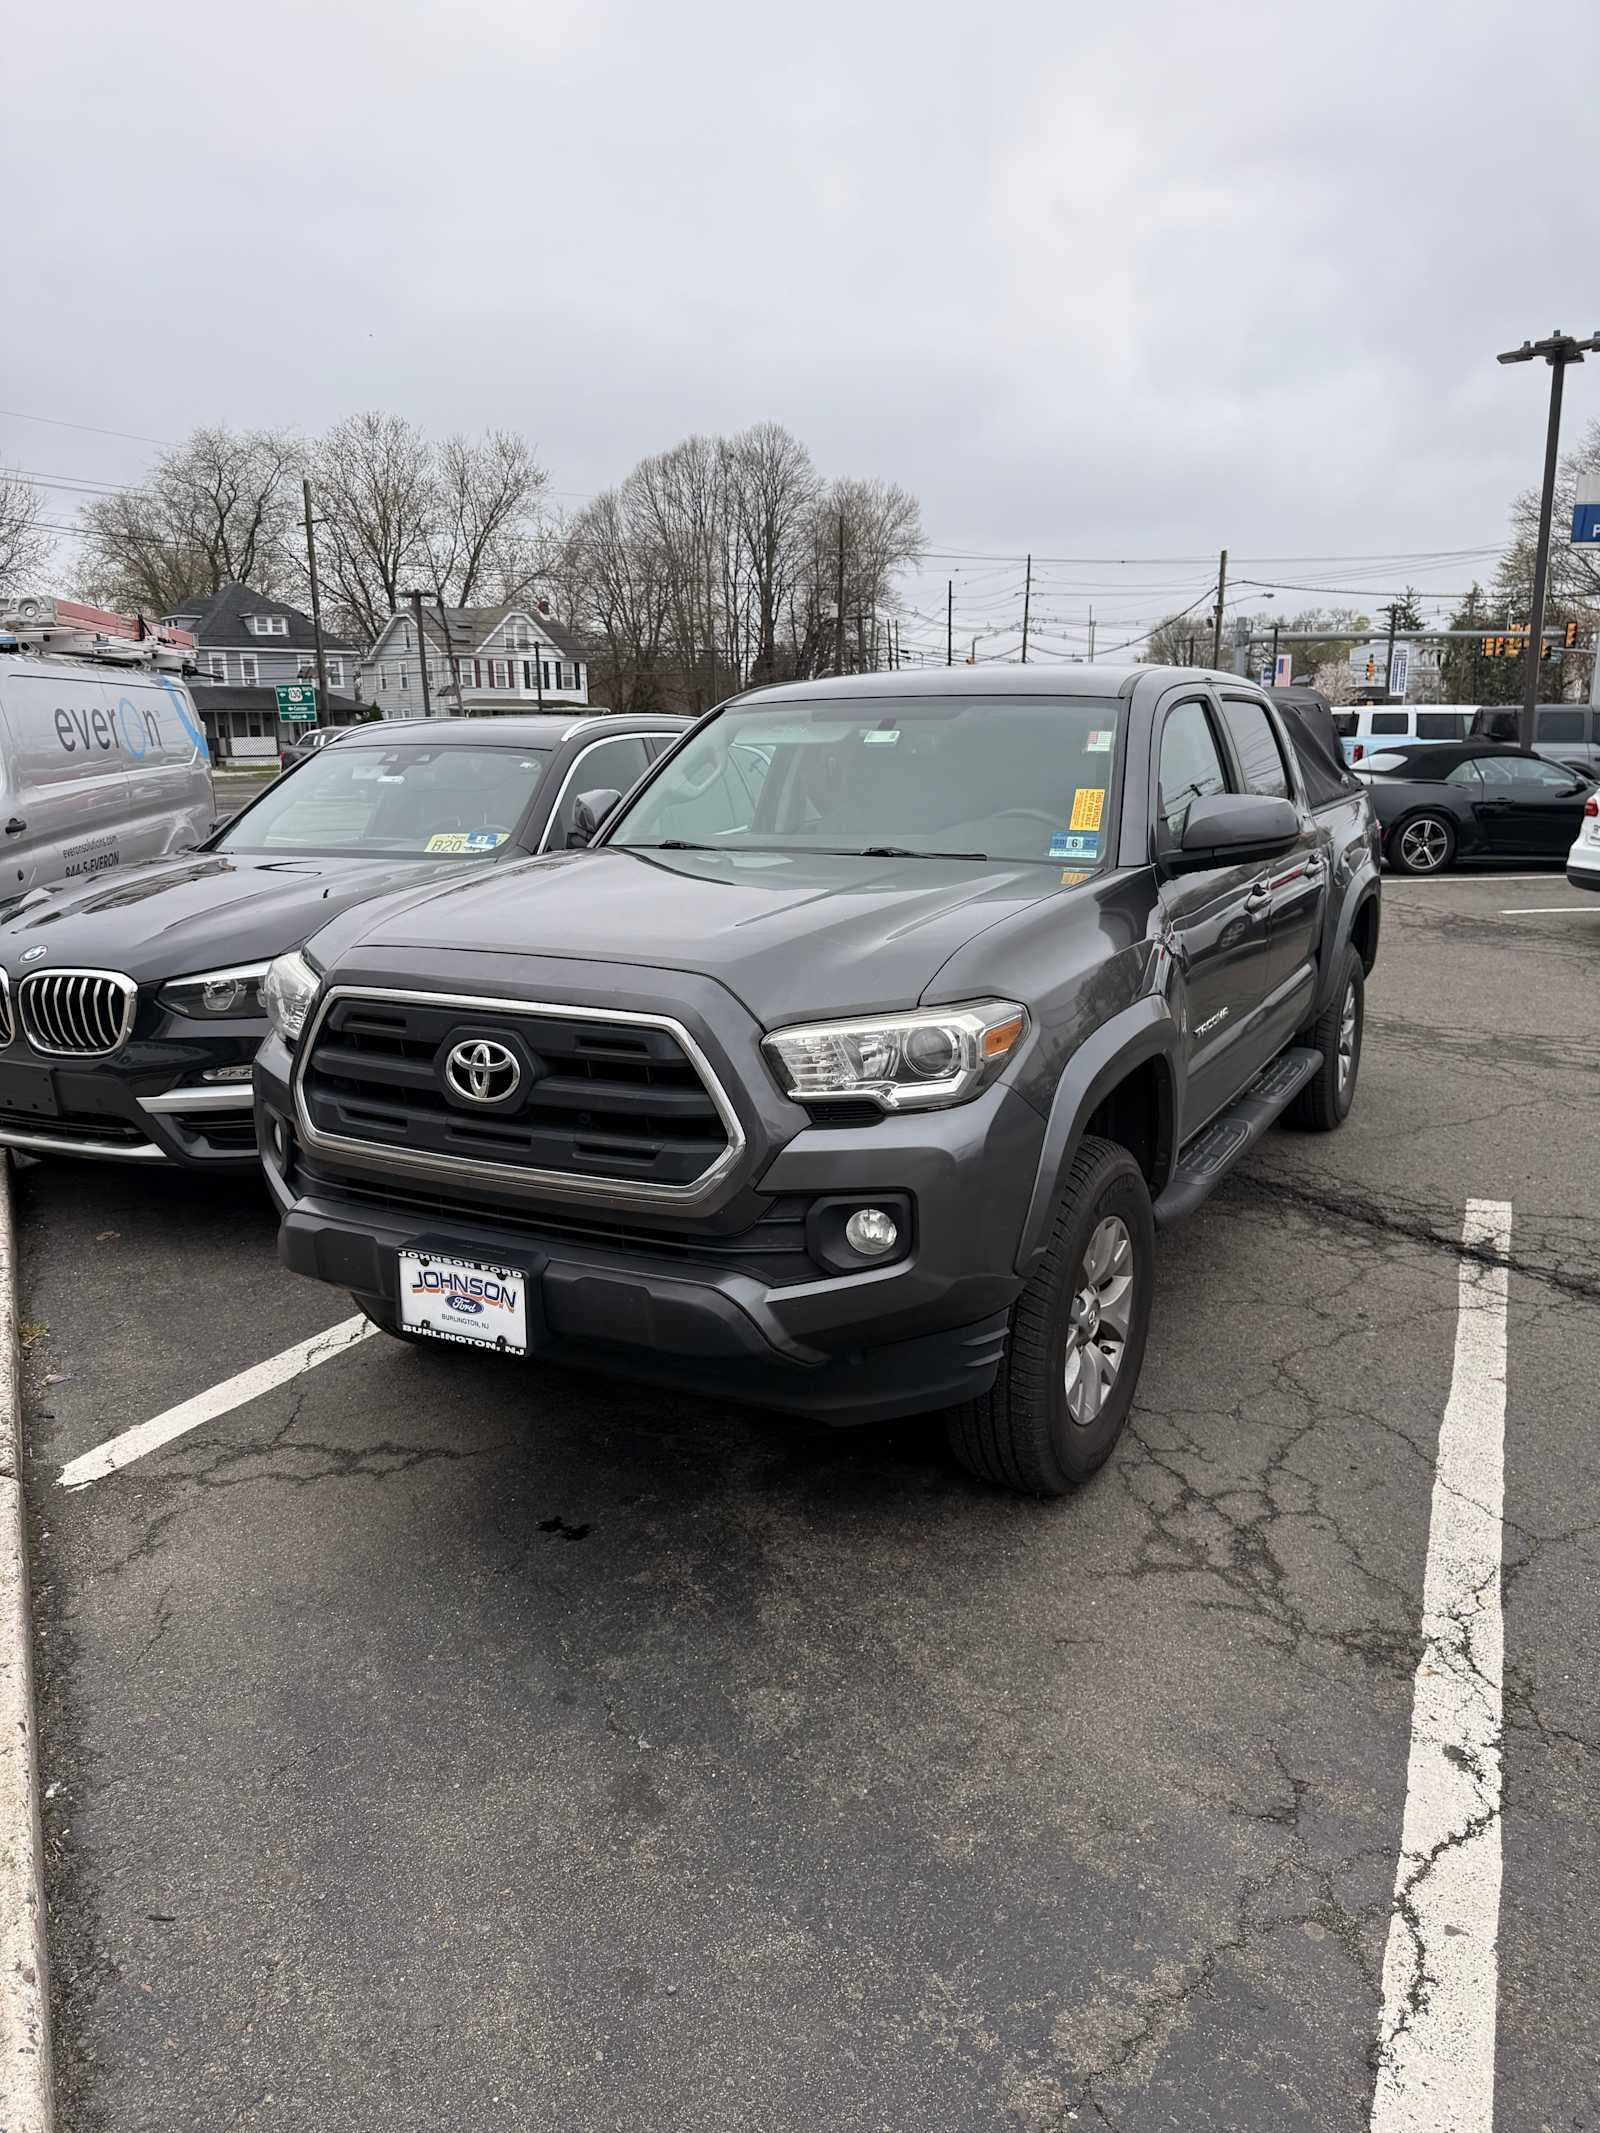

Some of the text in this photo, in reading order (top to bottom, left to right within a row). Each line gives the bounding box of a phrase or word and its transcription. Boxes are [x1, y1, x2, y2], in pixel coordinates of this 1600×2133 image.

[1071, 839, 1078, 847] 6
[398, 1250, 522, 1279] JOHNSON FORD
[412, 1270, 517, 1308] JOHNSON
[452, 1296, 477, 1314] Ford
[441, 1313, 490, 1330] BURLINGTON, NJ
[402, 1324, 525, 1356] BURLINGTON, NJ
